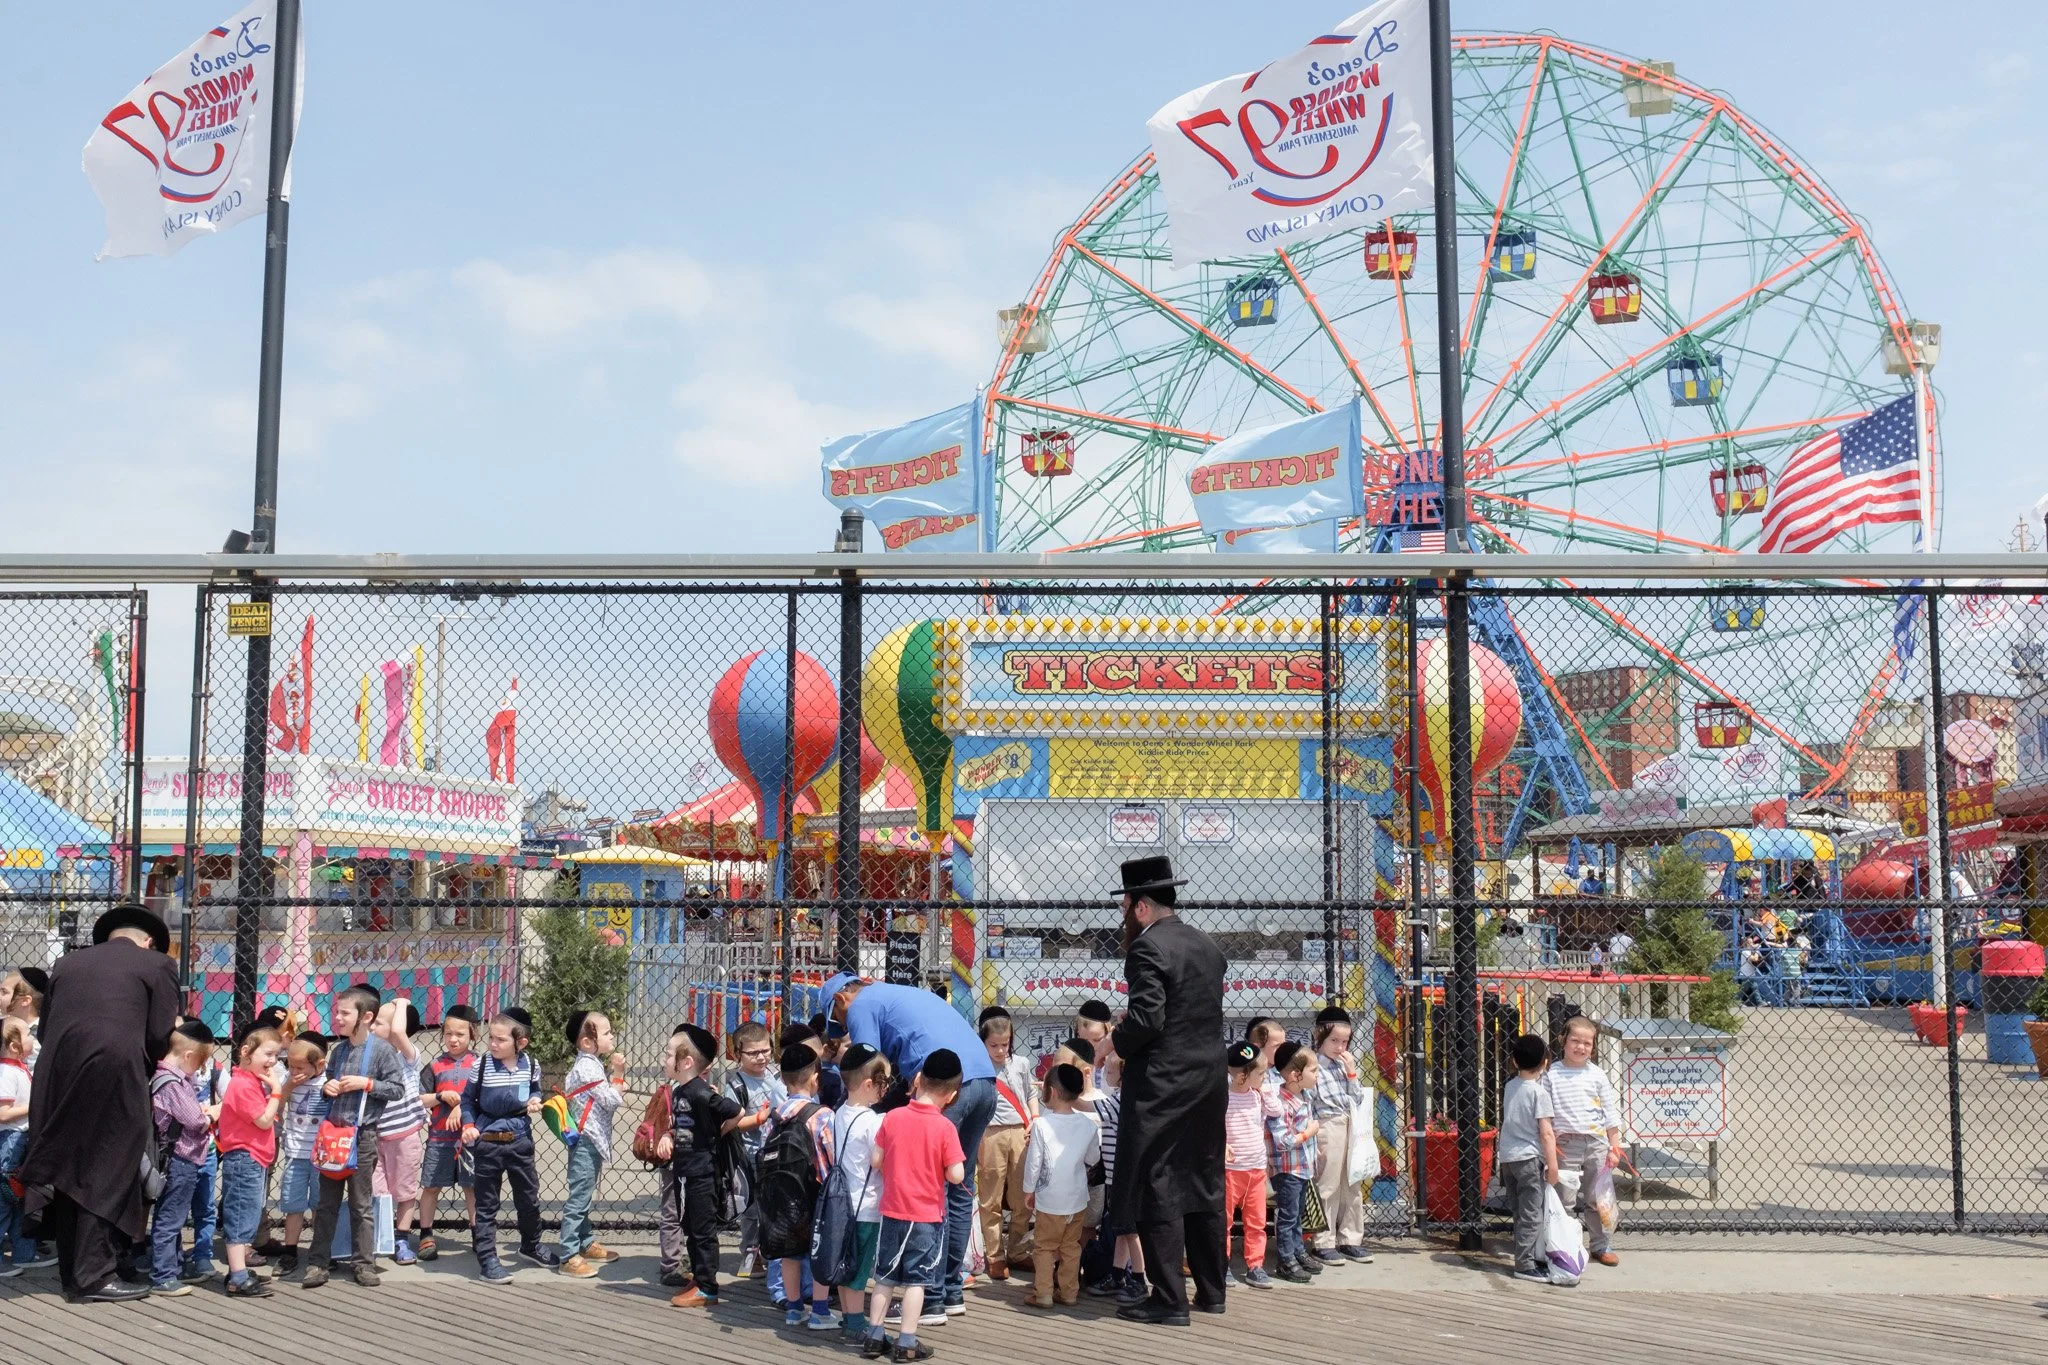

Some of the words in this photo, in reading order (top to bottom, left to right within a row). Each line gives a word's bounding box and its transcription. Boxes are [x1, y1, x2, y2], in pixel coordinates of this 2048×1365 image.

[1364, 488, 1482, 526] WHEL
[230, 606, 267, 616] IDEAL
[230, 617, 266, 627] FENCE
[1005, 653, 1342, 692] TICKETS
[1094, 739, 1129, 748] Welcome
[1132, 740, 1141, 748] to
[1143, 739, 1171, 748] Deno's
[1173, 739, 1204, 748] Wonder
[1205, 739, 1232, 748] Wheel
[1234, 739, 1253, 748] Park
[1138, 749, 1164, 757] Kiddie
[1165, 749, 1184, 757] Ride
[1186, 749, 1210, 757] Prices
[967, 754, 1001, 778] WONDER
[230, 772, 293, 798] SPPE
[367, 778, 435, 814] SWEET
[438, 788, 507, 822] SHOPPE
[889, 940, 918, 950] Please
[891, 955, 914, 964] Enter
[892, 969, 913, 979] Here
[1650, 1066, 1675, 1074] These
[1677, 1065, 1702, 1074] tables
[1690, 1076, 1702, 1085] for
[1655, 1098, 1699, 1106] Customers
[1654, 1119, 1680, 1128] Thank
[1684, 1121, 1701, 1130] you
